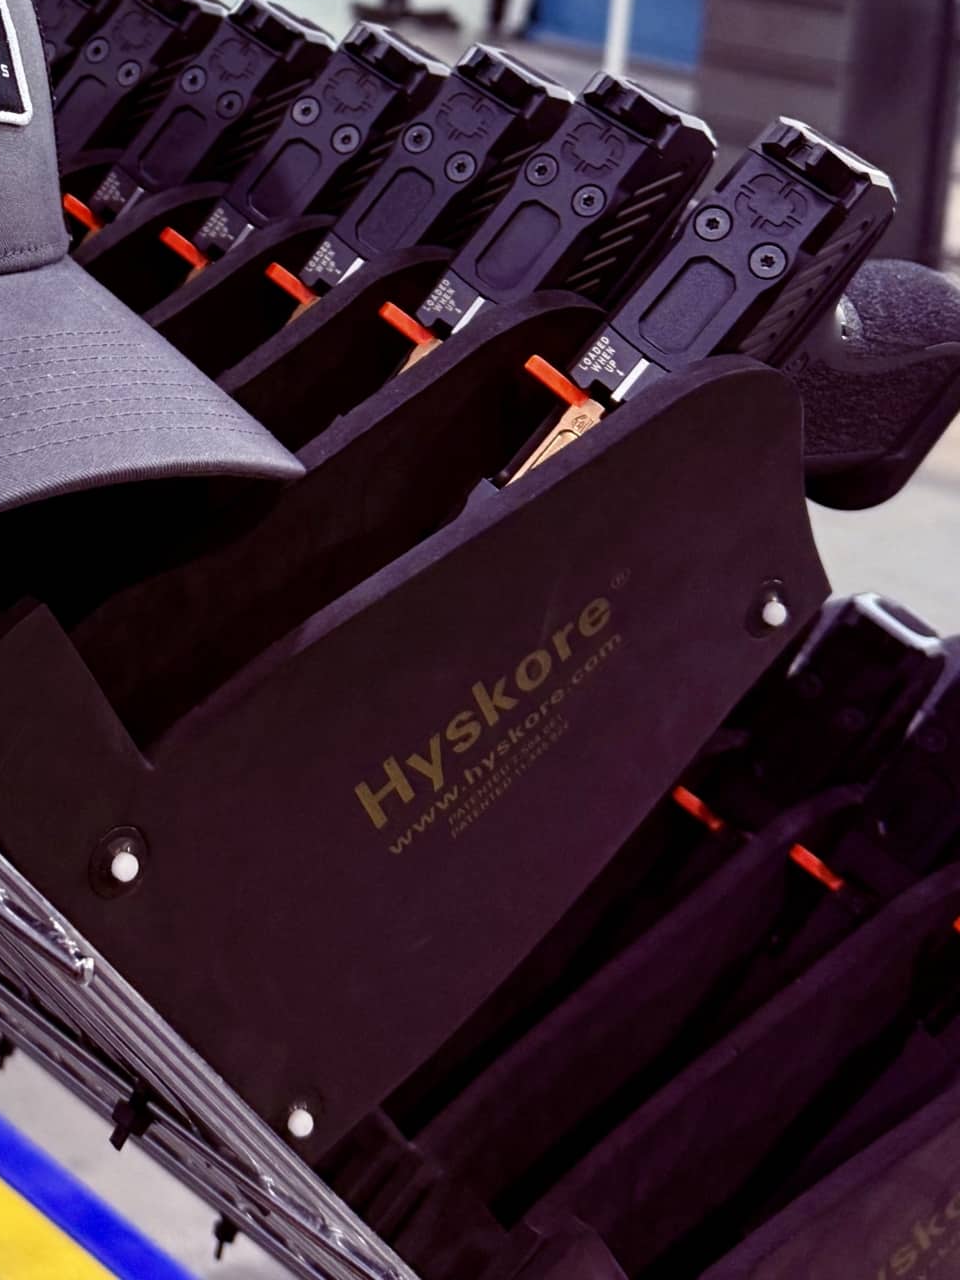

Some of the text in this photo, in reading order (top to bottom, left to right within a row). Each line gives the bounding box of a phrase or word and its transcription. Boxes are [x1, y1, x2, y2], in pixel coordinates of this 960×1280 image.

[578, 336, 609, 370] LOADED
[590, 345, 616, 372] WHEN
[604, 359, 616, 372] UP
[354, 597, 611, 829] Hyskore
[389, 633, 622, 854] www.hyskore.com
